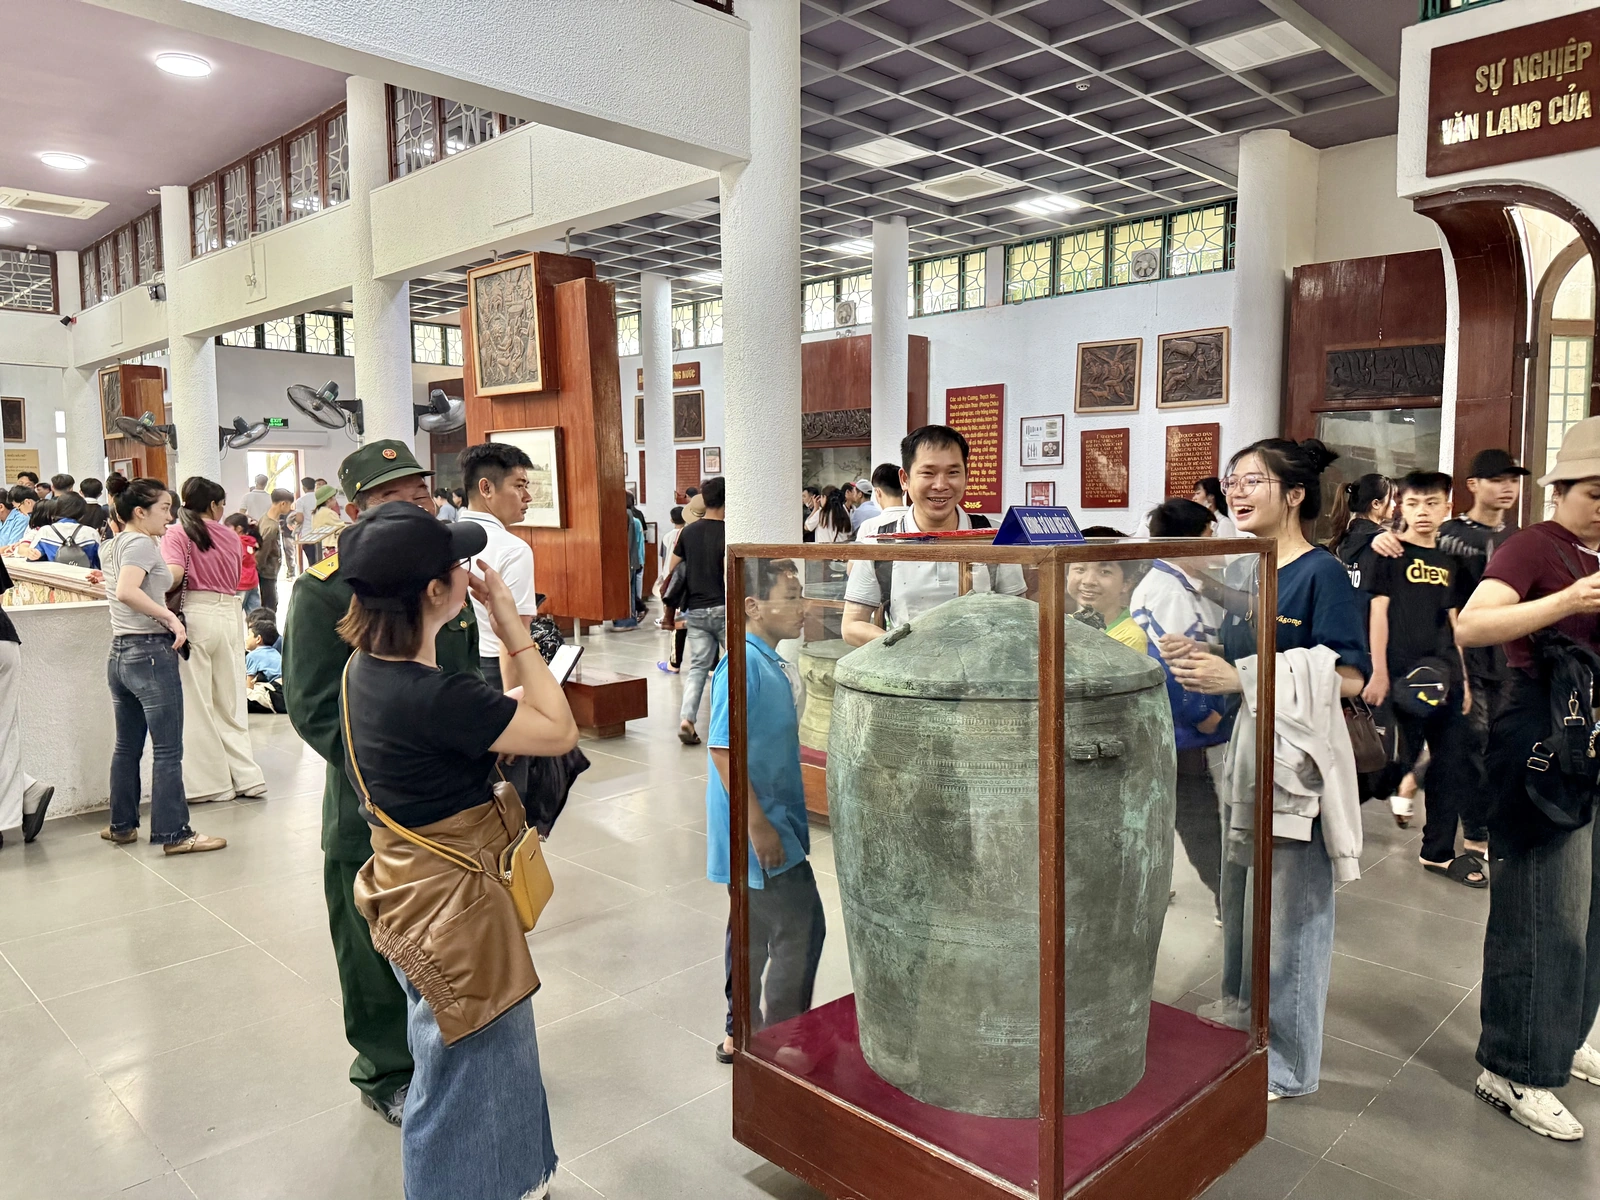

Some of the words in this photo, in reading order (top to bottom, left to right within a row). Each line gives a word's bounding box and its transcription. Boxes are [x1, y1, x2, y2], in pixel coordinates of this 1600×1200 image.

[1475, 58, 1506, 96] SỰ
[1512, 37, 1592, 85] NGHIỆP
[1441, 110, 1480, 146] VĂN
[1486, 100, 1542, 137] LANG
[1548, 83, 1592, 125] CỦA
